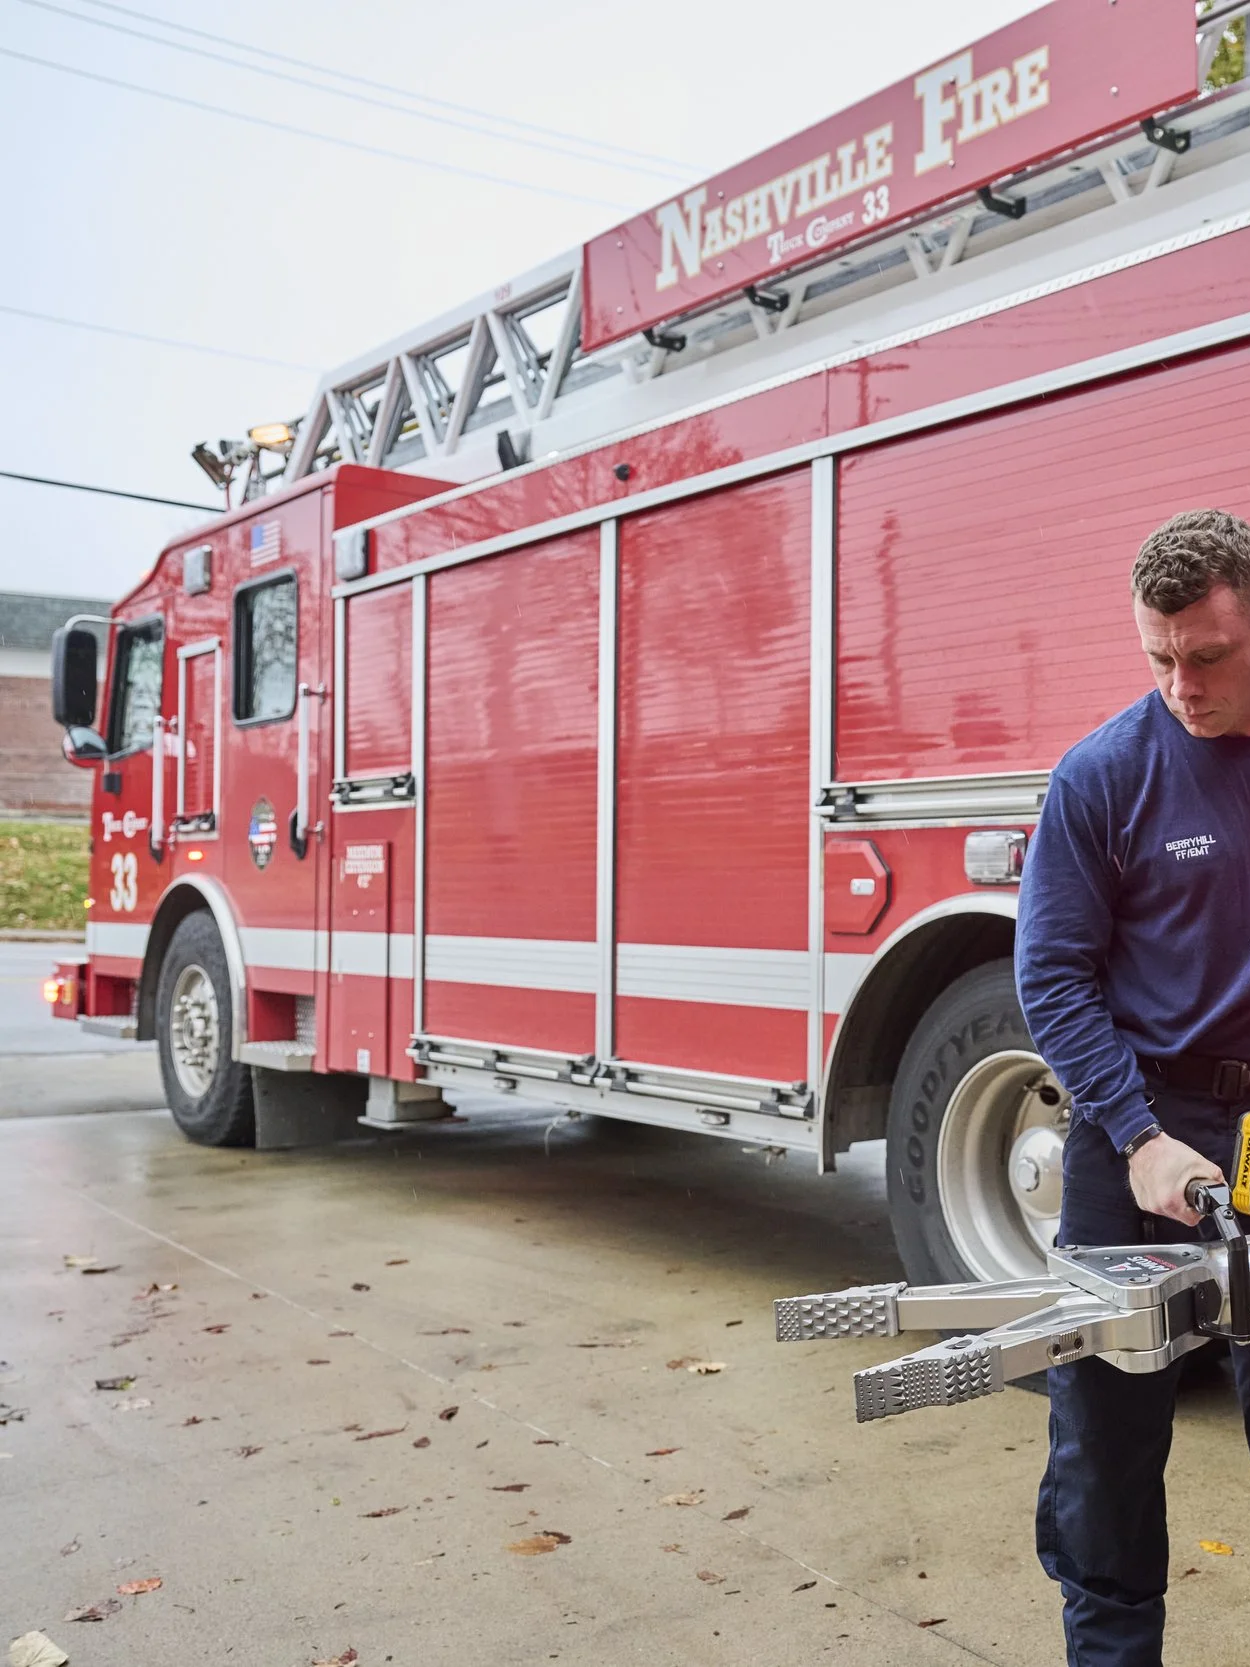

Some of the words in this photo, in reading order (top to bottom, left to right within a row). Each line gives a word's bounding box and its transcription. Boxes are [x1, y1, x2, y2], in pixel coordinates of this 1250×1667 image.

[860, 184, 890, 225] 33
[1166, 835, 1215, 851] BERRYHILL
[1176, 846, 1209, 860] FF/EMT
[110, 852, 138, 912] 33
